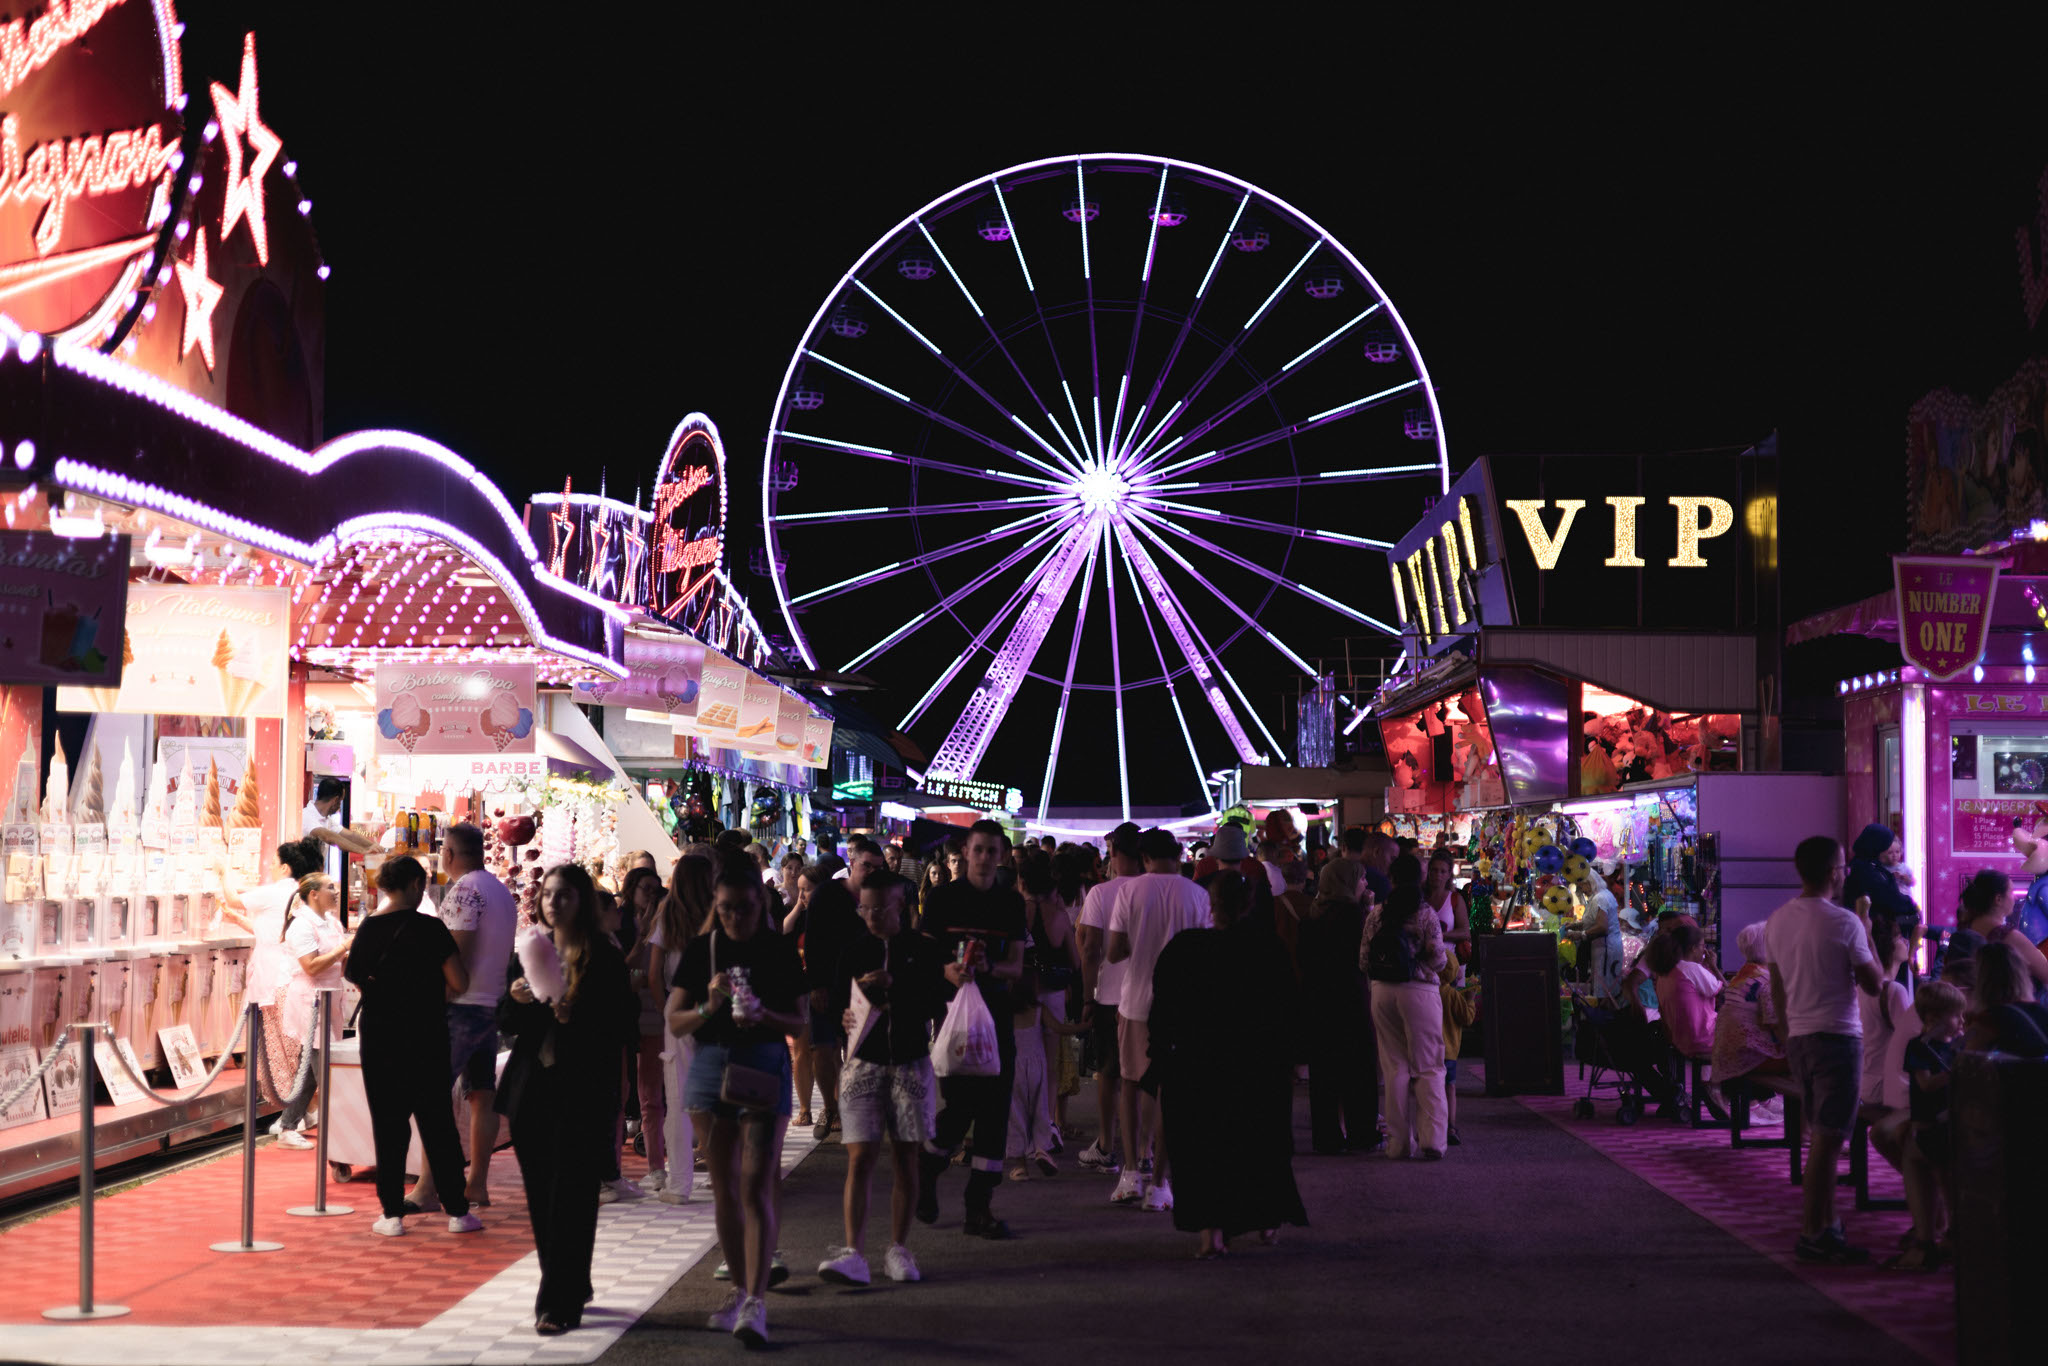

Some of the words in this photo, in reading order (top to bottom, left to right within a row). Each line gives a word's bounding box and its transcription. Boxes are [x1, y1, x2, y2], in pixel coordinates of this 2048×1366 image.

[1506, 496, 1734, 570] VIP
[1408, 520, 1467, 645] VIP
[1939, 572, 1953, 586] LE
[1908, 590, 1982, 615] NUMBER
[1919, 621, 1969, 654] ONE
[388, 670, 451, 694] Barbe
[1963, 694, 2028, 713] LE
[471, 761, 541, 775] BARBE
[948, 784, 1000, 804] KITSCH
[1974, 800, 2026, 812] NUMBER
[1983, 832, 2005, 840] Places
[0, 1024, 31, 1046] utella
